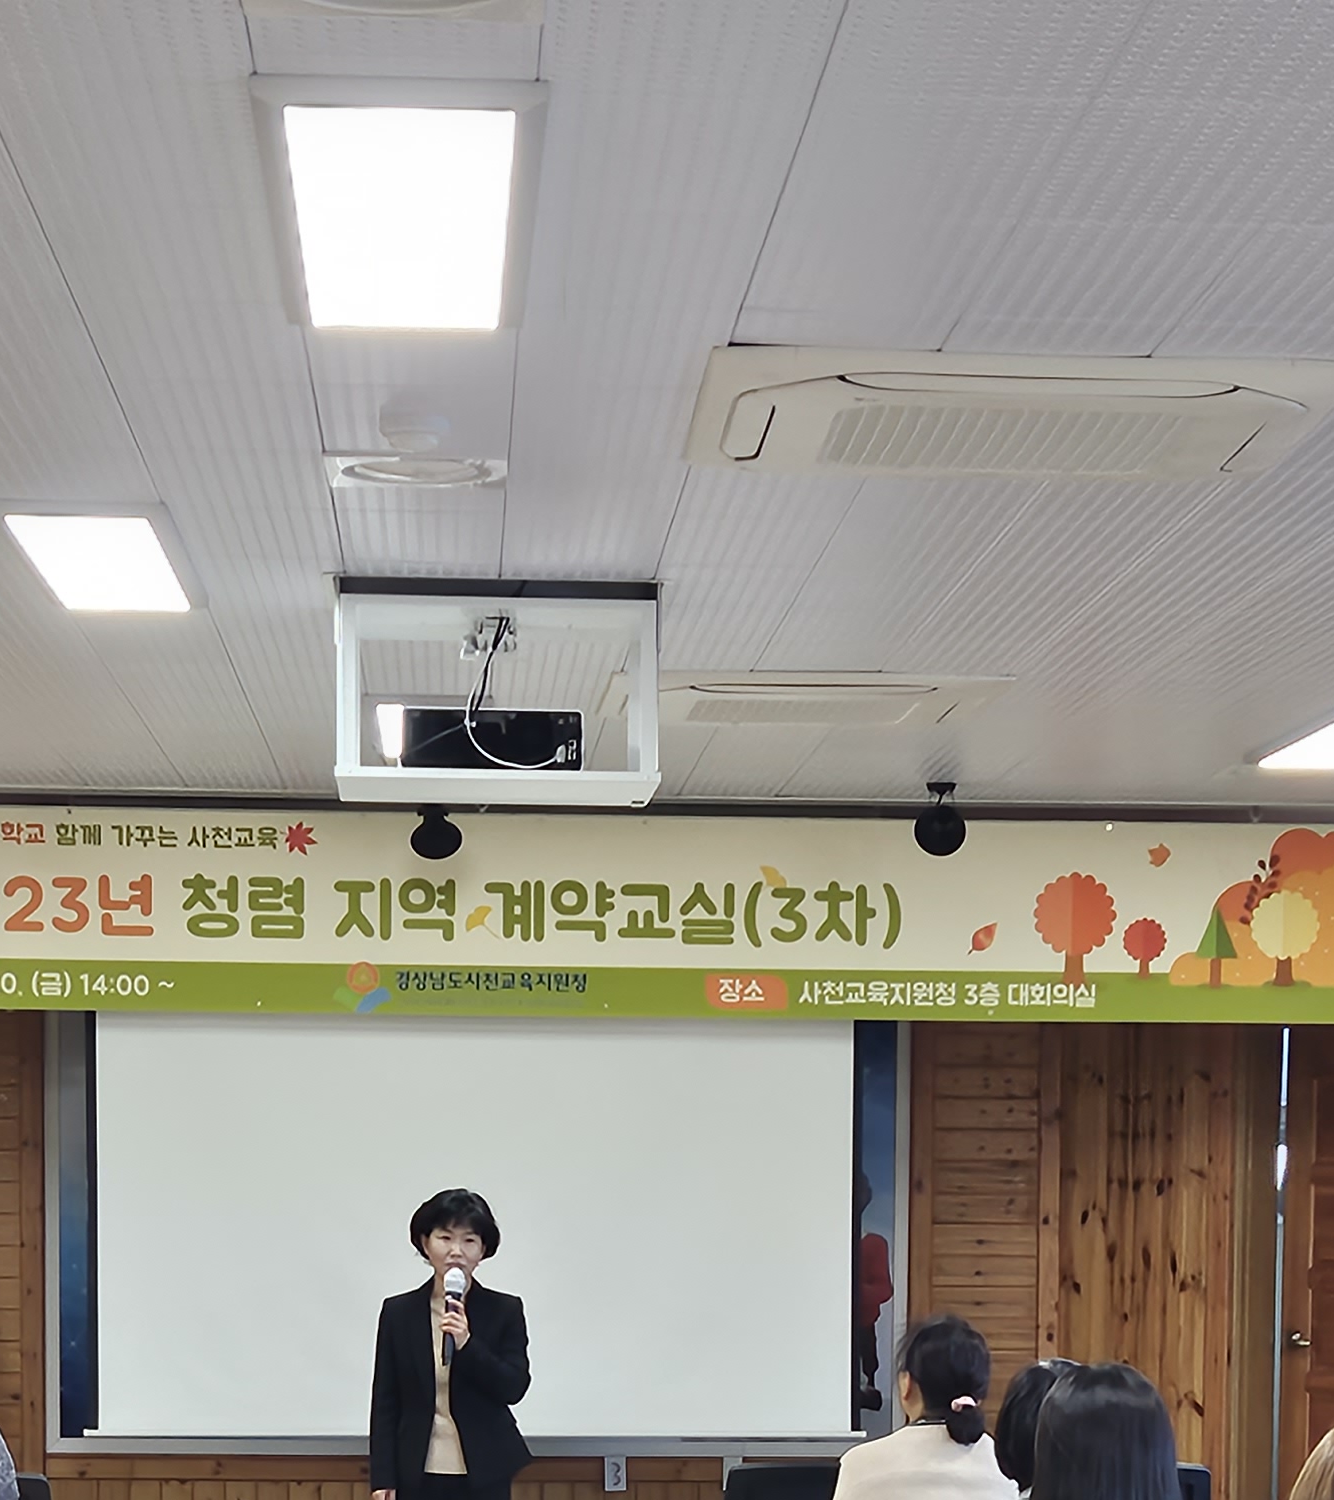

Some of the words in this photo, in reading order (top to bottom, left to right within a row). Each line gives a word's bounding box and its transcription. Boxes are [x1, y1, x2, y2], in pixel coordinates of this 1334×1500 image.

[0, 821, 47, 845] 학교
[55, 822, 102, 846] 함께
[111, 824, 178, 848] 가꾸는
[187, 825, 279, 849] 사천교육
[181, 873, 306, 940] 청렴
[333, 876, 457, 943] 지역
[483, 879, 903, 950] 계약교실(3차)
[31, 970, 72, 998] (금)
[79, 973, 150, 997] 14:00
[718, 978, 766, 1003] 장소
[798, 981, 957, 1007] 사천교육지원청
[964, 981, 1001, 1007] 3층
[1008, 982, 1097, 1008] 대회의실
